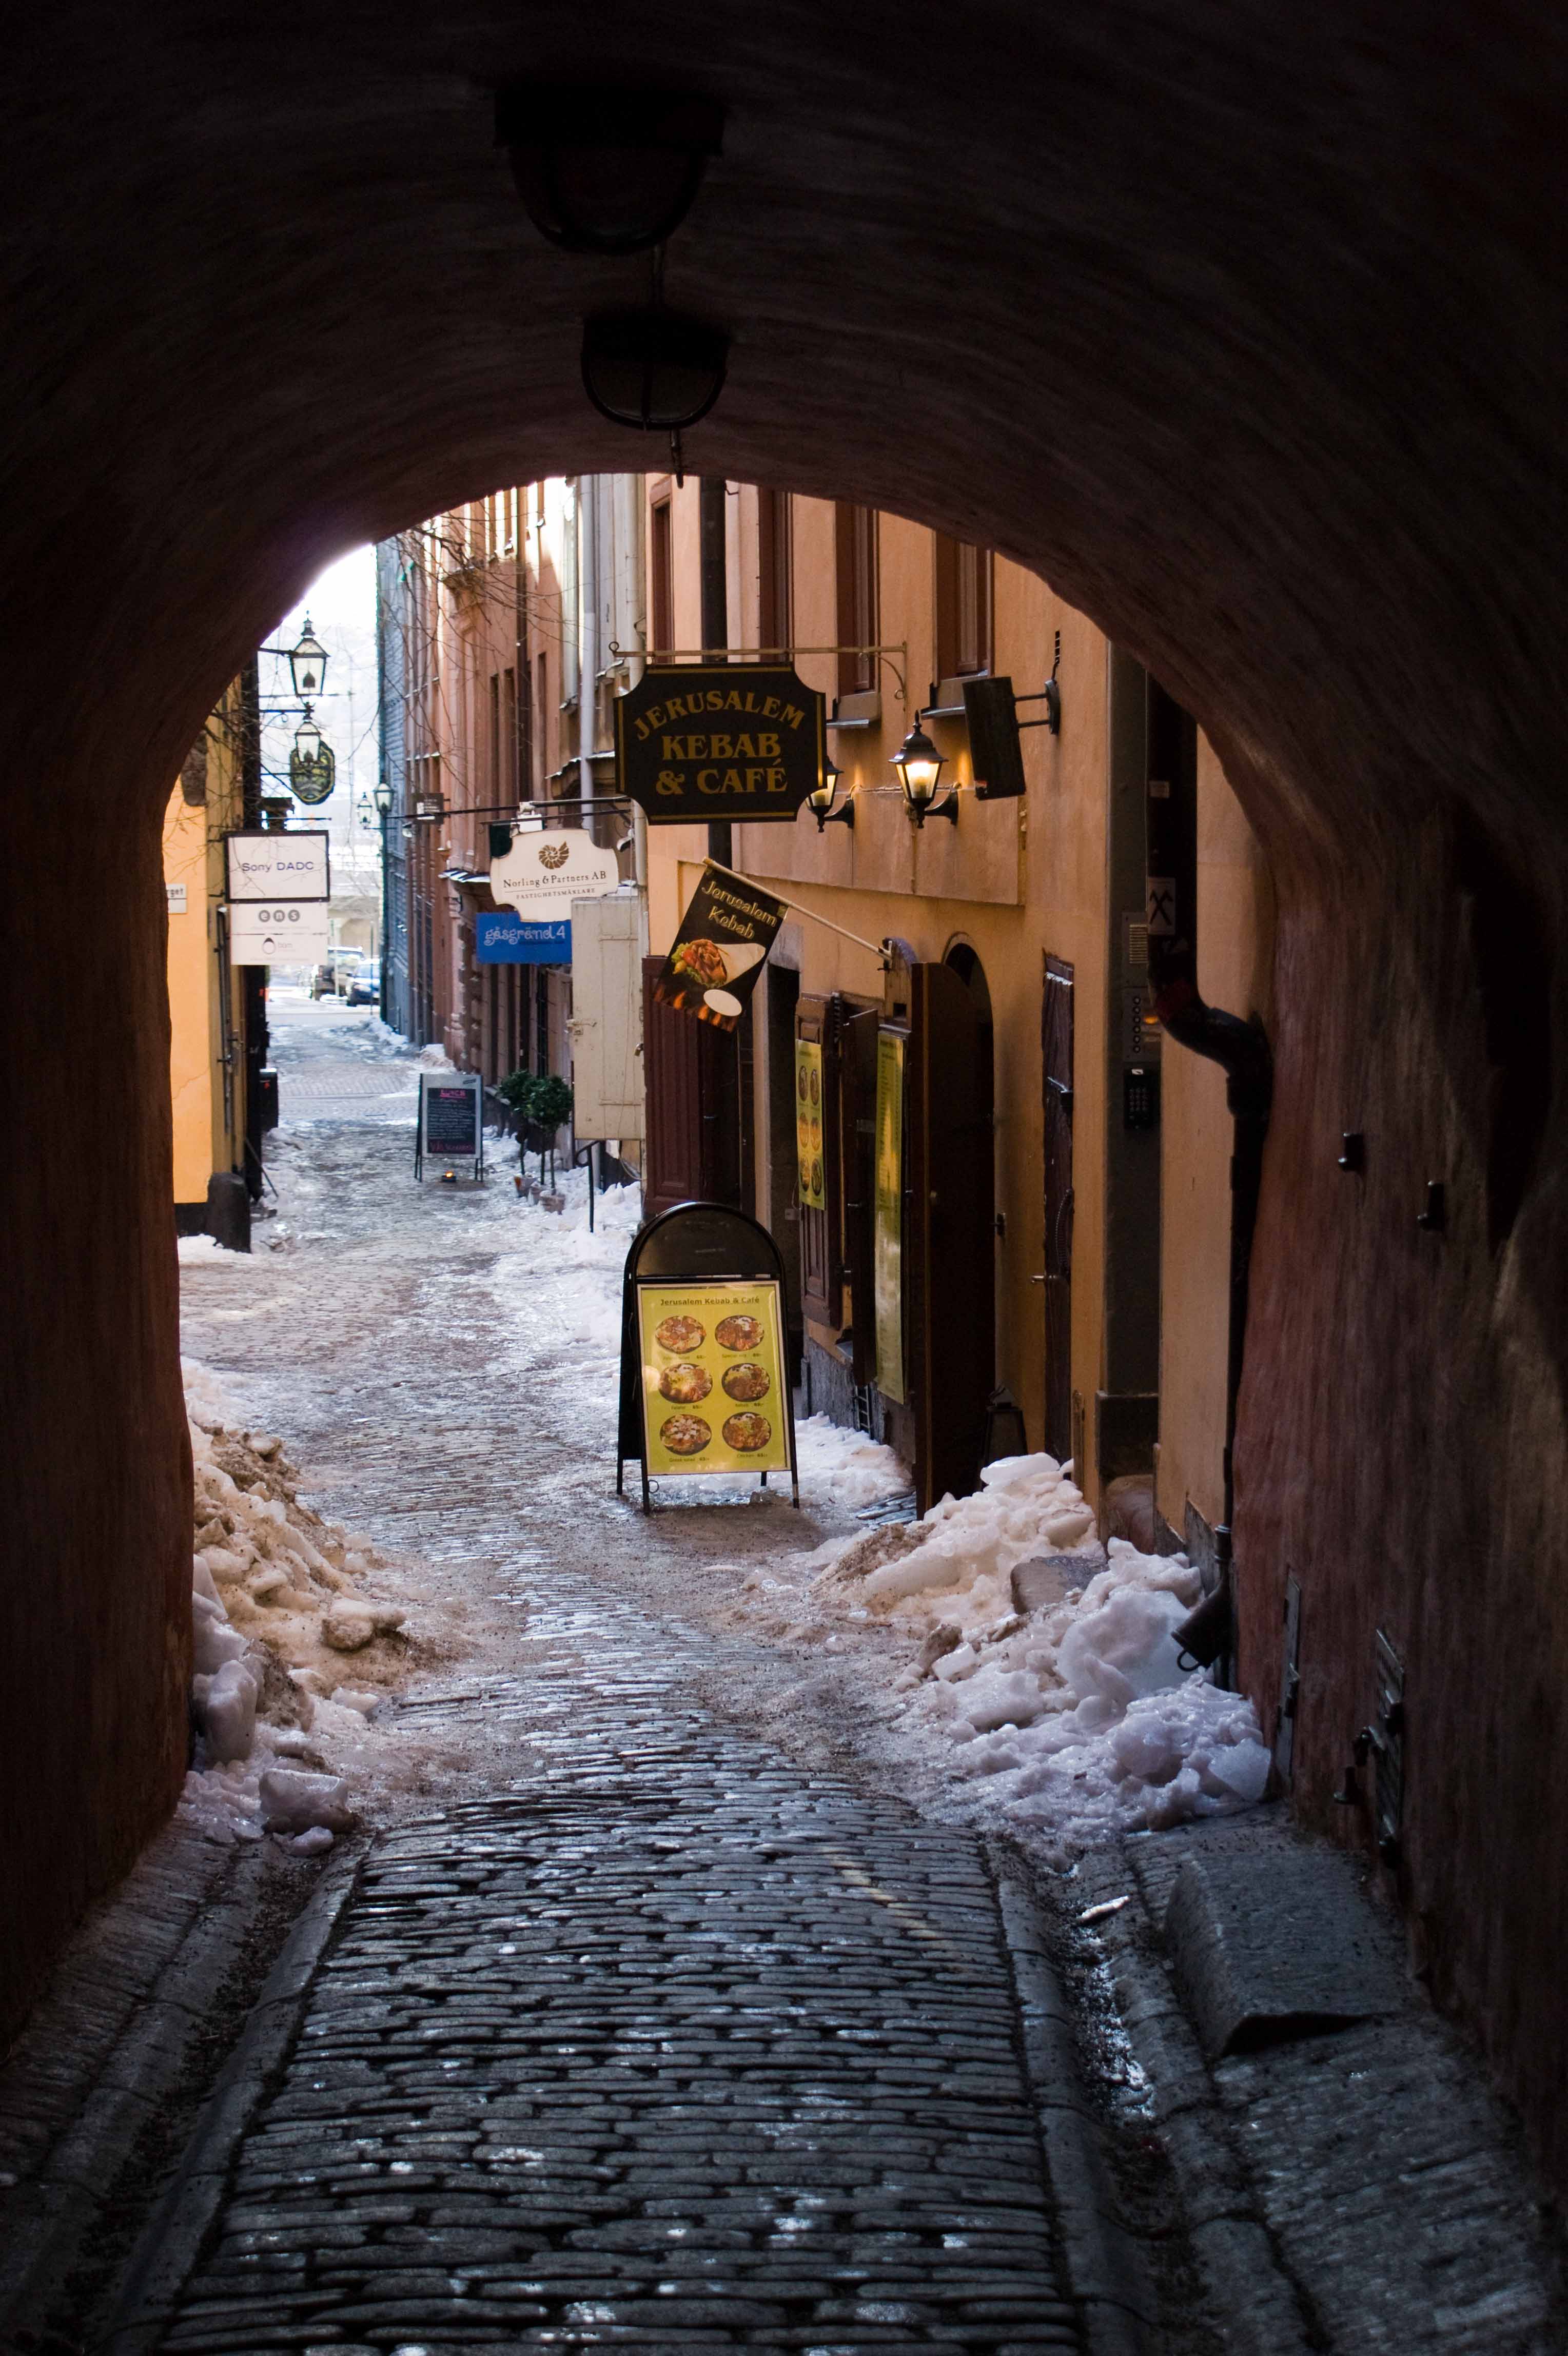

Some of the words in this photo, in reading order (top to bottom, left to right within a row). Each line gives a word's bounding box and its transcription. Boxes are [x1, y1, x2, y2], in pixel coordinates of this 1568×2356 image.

[634, 690, 805, 740] JERUSALEM
[662, 733, 781, 760] KEBAB
[656, 770, 685, 795] &
[697, 758, 788, 794] CAFÉ
[242, 862, 271, 873] Sony
[276, 861, 313, 871] DADC
[503, 878, 540, 888] Norling
[542, 876, 548, 884] &
[551, 874, 589, 883] Partners
[591, 871, 606, 880] AB
[259, 910, 300, 922] ens
[701, 881, 777, 927] Jerusalem
[556, 925, 565, 939] 4
[708, 906, 755, 939] Kebab
